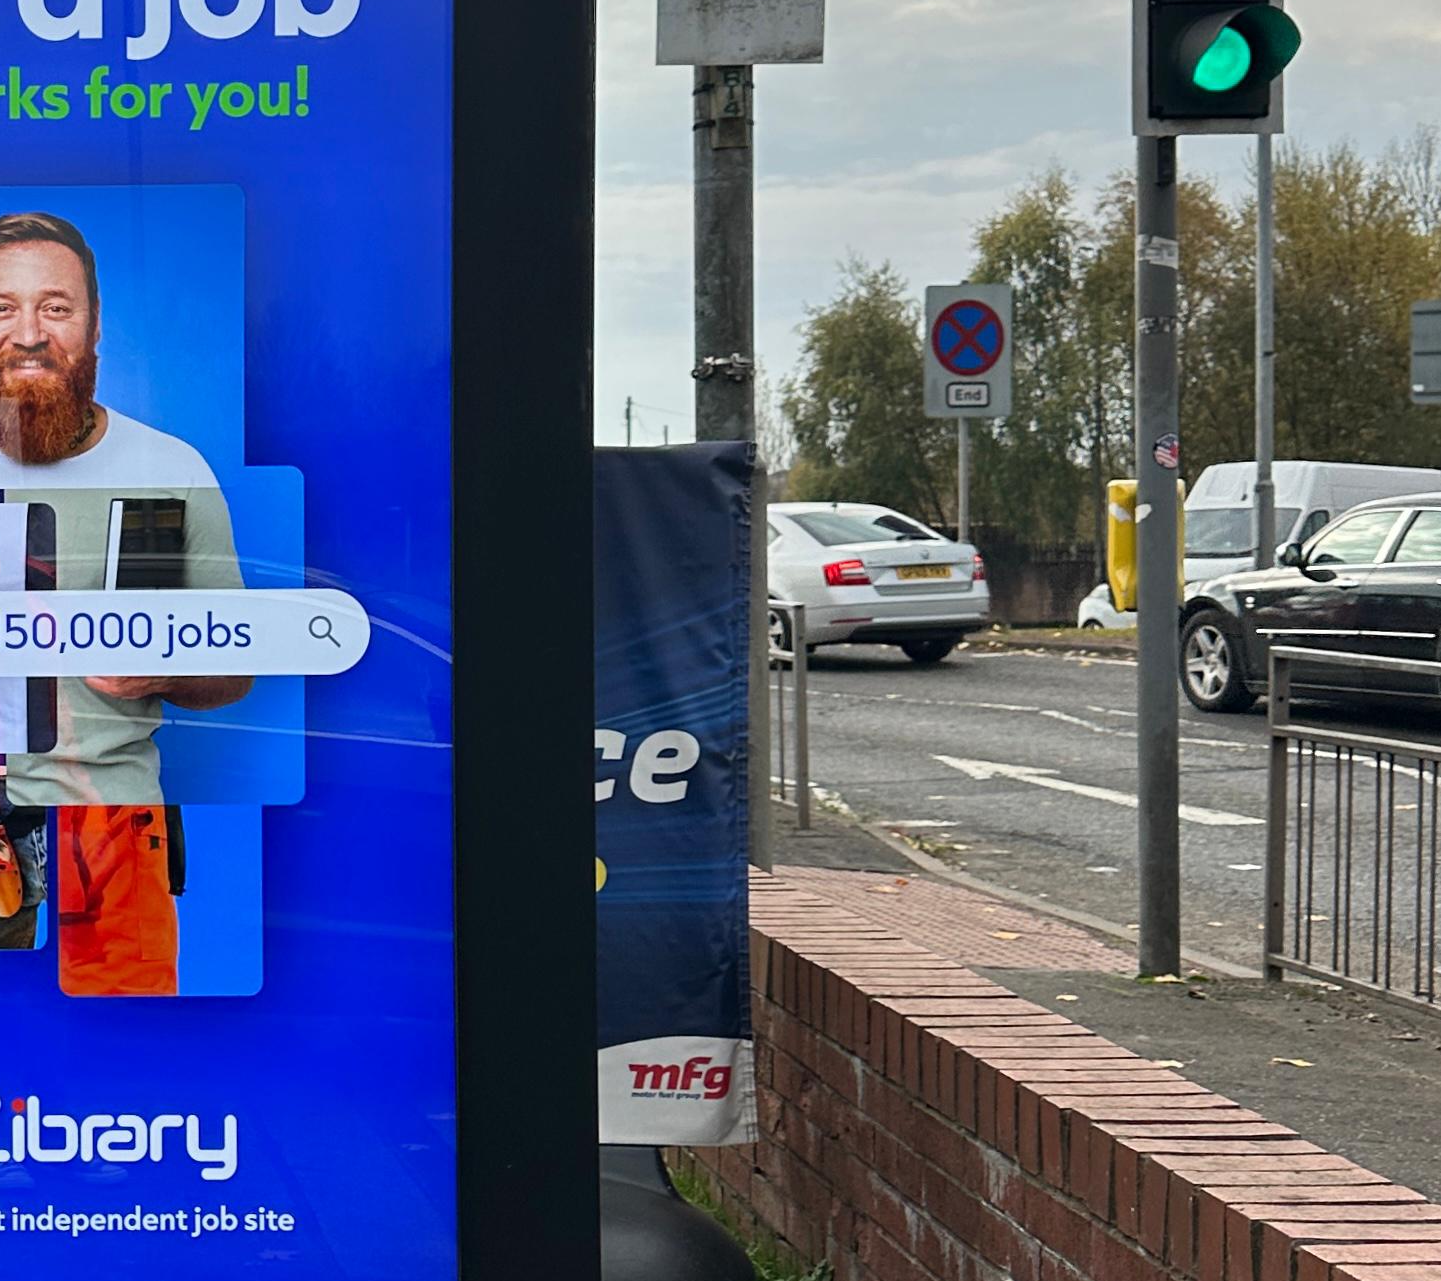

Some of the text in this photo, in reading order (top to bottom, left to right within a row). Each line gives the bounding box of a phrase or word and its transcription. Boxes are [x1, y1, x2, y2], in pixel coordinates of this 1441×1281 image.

[85, 66, 172, 120] for
[187, 64, 309, 130] you!
[954, 388, 982, 401] End
[161, 609, 253, 660] jobs
[628, 1056, 732, 1100] mfg
[10, 1204, 189, 1237] independent
[190, 1204, 239, 1238] job
[243, 1205, 296, 1232] site
